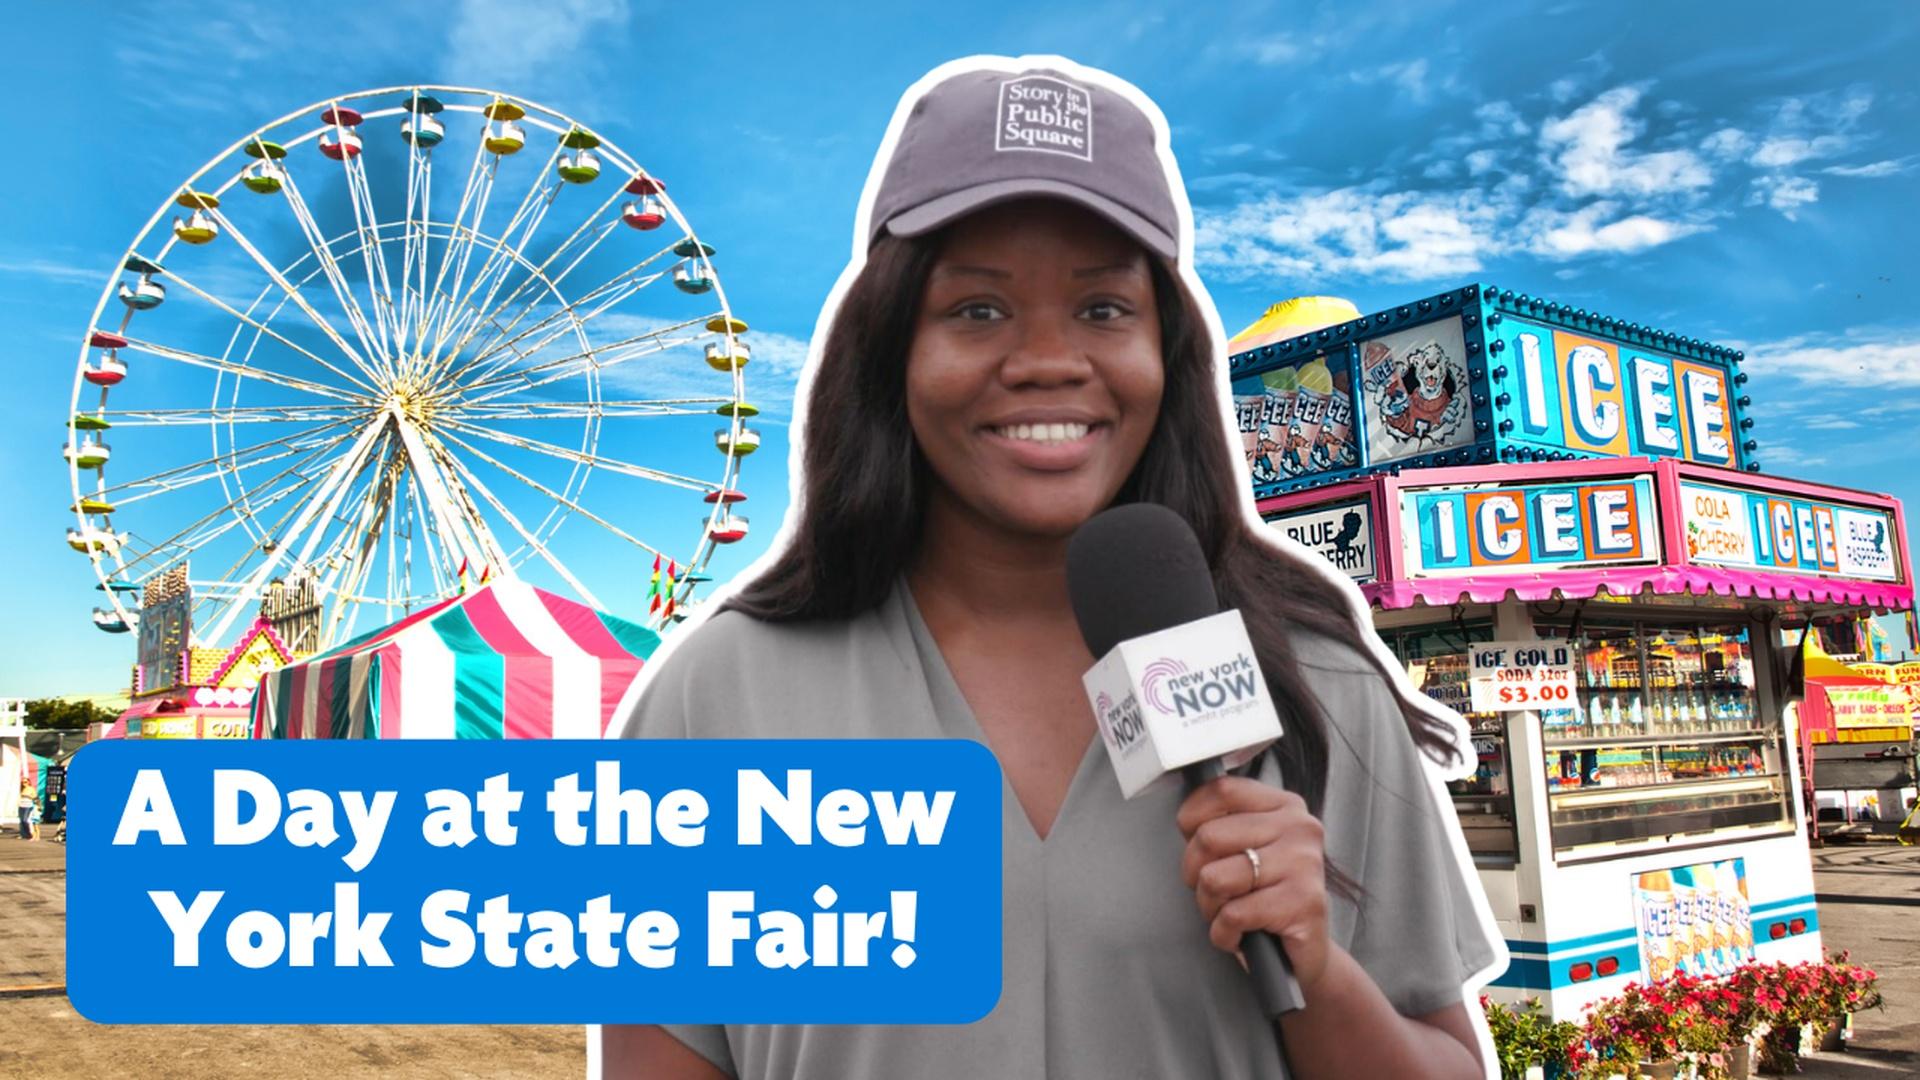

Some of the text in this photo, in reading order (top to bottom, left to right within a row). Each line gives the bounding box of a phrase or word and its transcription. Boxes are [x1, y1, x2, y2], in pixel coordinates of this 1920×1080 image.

[1009, 84, 1063, 112] Story
[1066, 101, 1088, 116] the
[1067, 88, 1080, 103] in
[1008, 103, 1084, 132] Public
[1005, 122, 1084, 149] Square
[1514, 333, 1729, 464] ICEE
[1695, 496, 1731, 520] COLA
[1287, 520, 1335, 547] BLUE
[1433, 490, 1633, 561] ICEE
[1755, 503, 1837, 567] ICEE
[1698, 529, 1745, 557] CHERRY
[1475, 647, 1568, 669] ICE COLD
[1167, 653, 1252, 692] new york
[1497, 668, 1534, 682] SODA
[1172, 670, 1256, 718] NOW
[1499, 685, 1569, 703] $3.00
[1108, 706, 1122, 722] new
[1113, 706, 1145, 750] NOW
